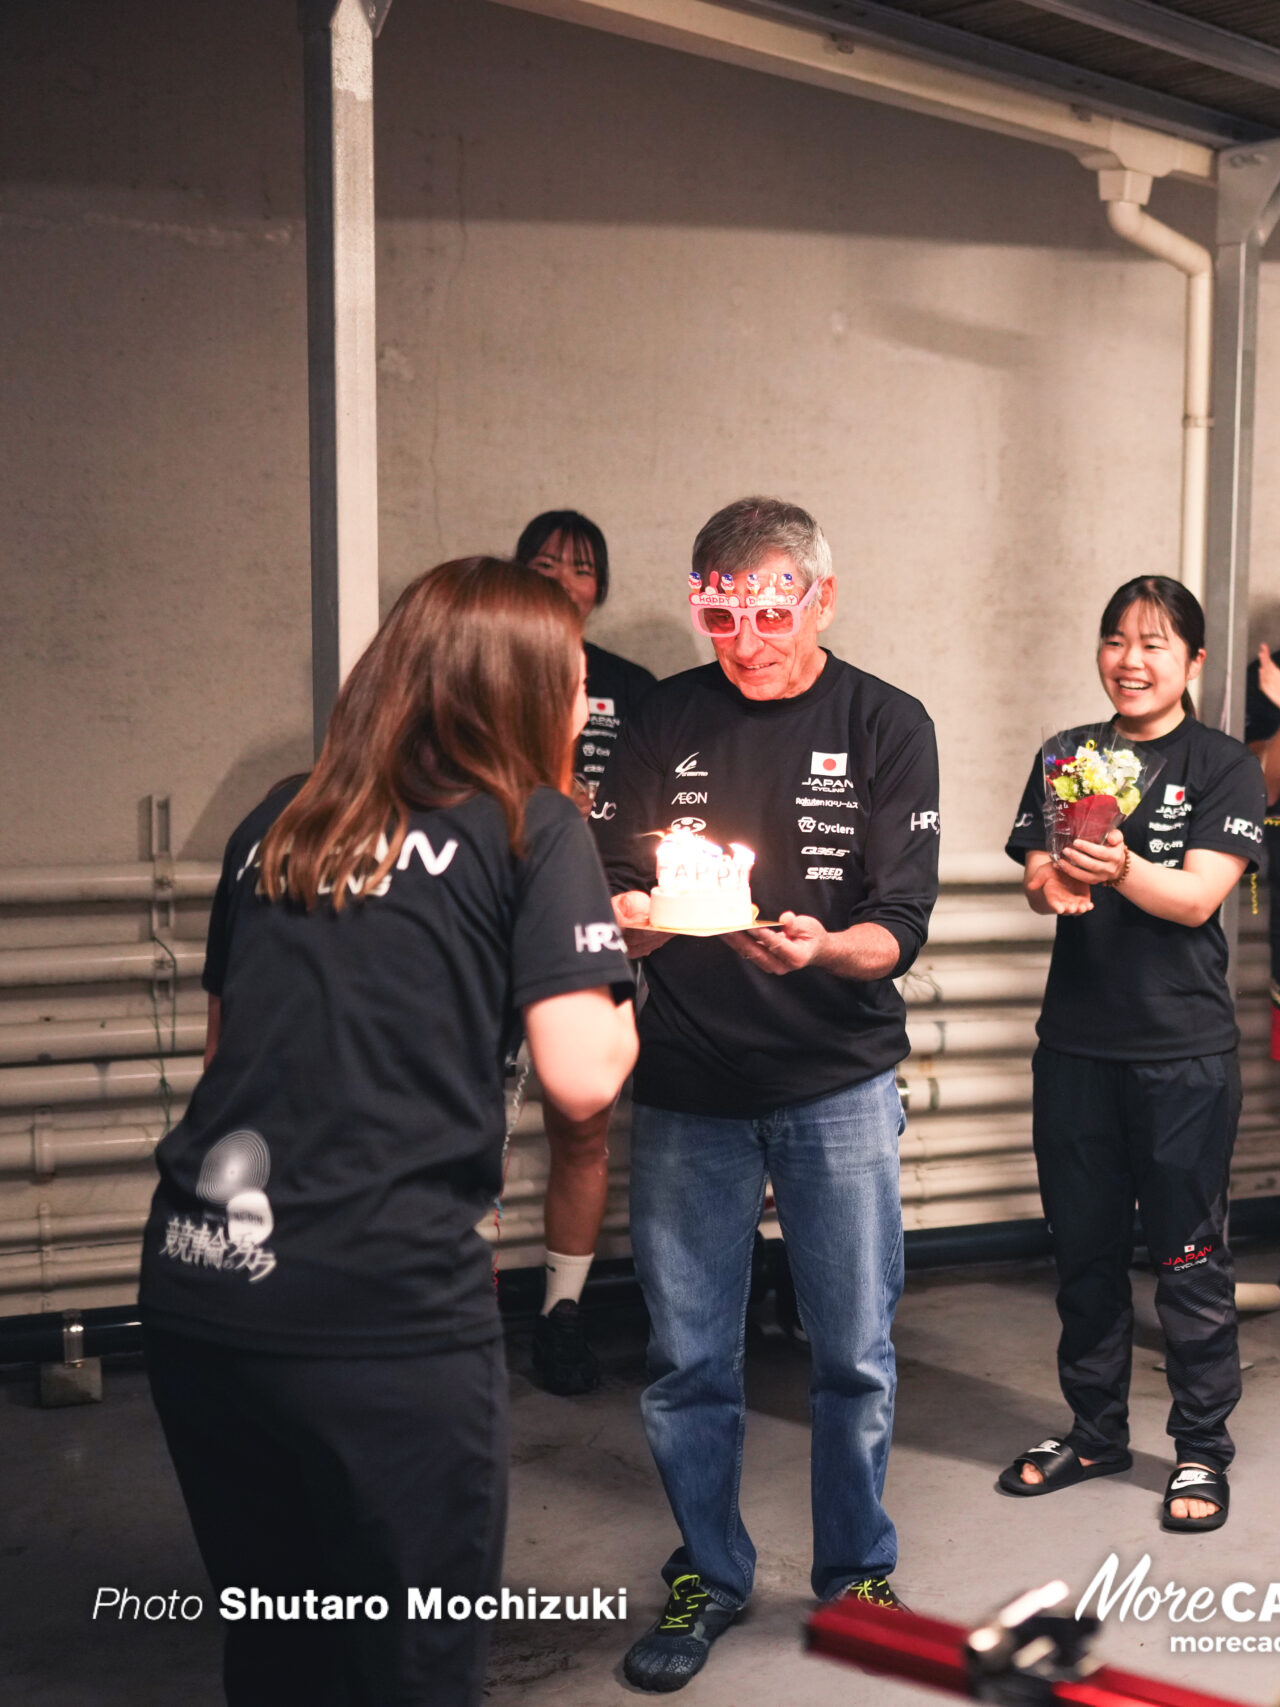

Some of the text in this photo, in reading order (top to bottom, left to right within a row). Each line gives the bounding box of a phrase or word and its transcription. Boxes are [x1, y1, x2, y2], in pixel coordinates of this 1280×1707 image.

[801, 778, 854, 789] JAPAN
[817, 822, 855, 835] Cyclers
[1162, 1245, 1213, 1266] JAPAN
